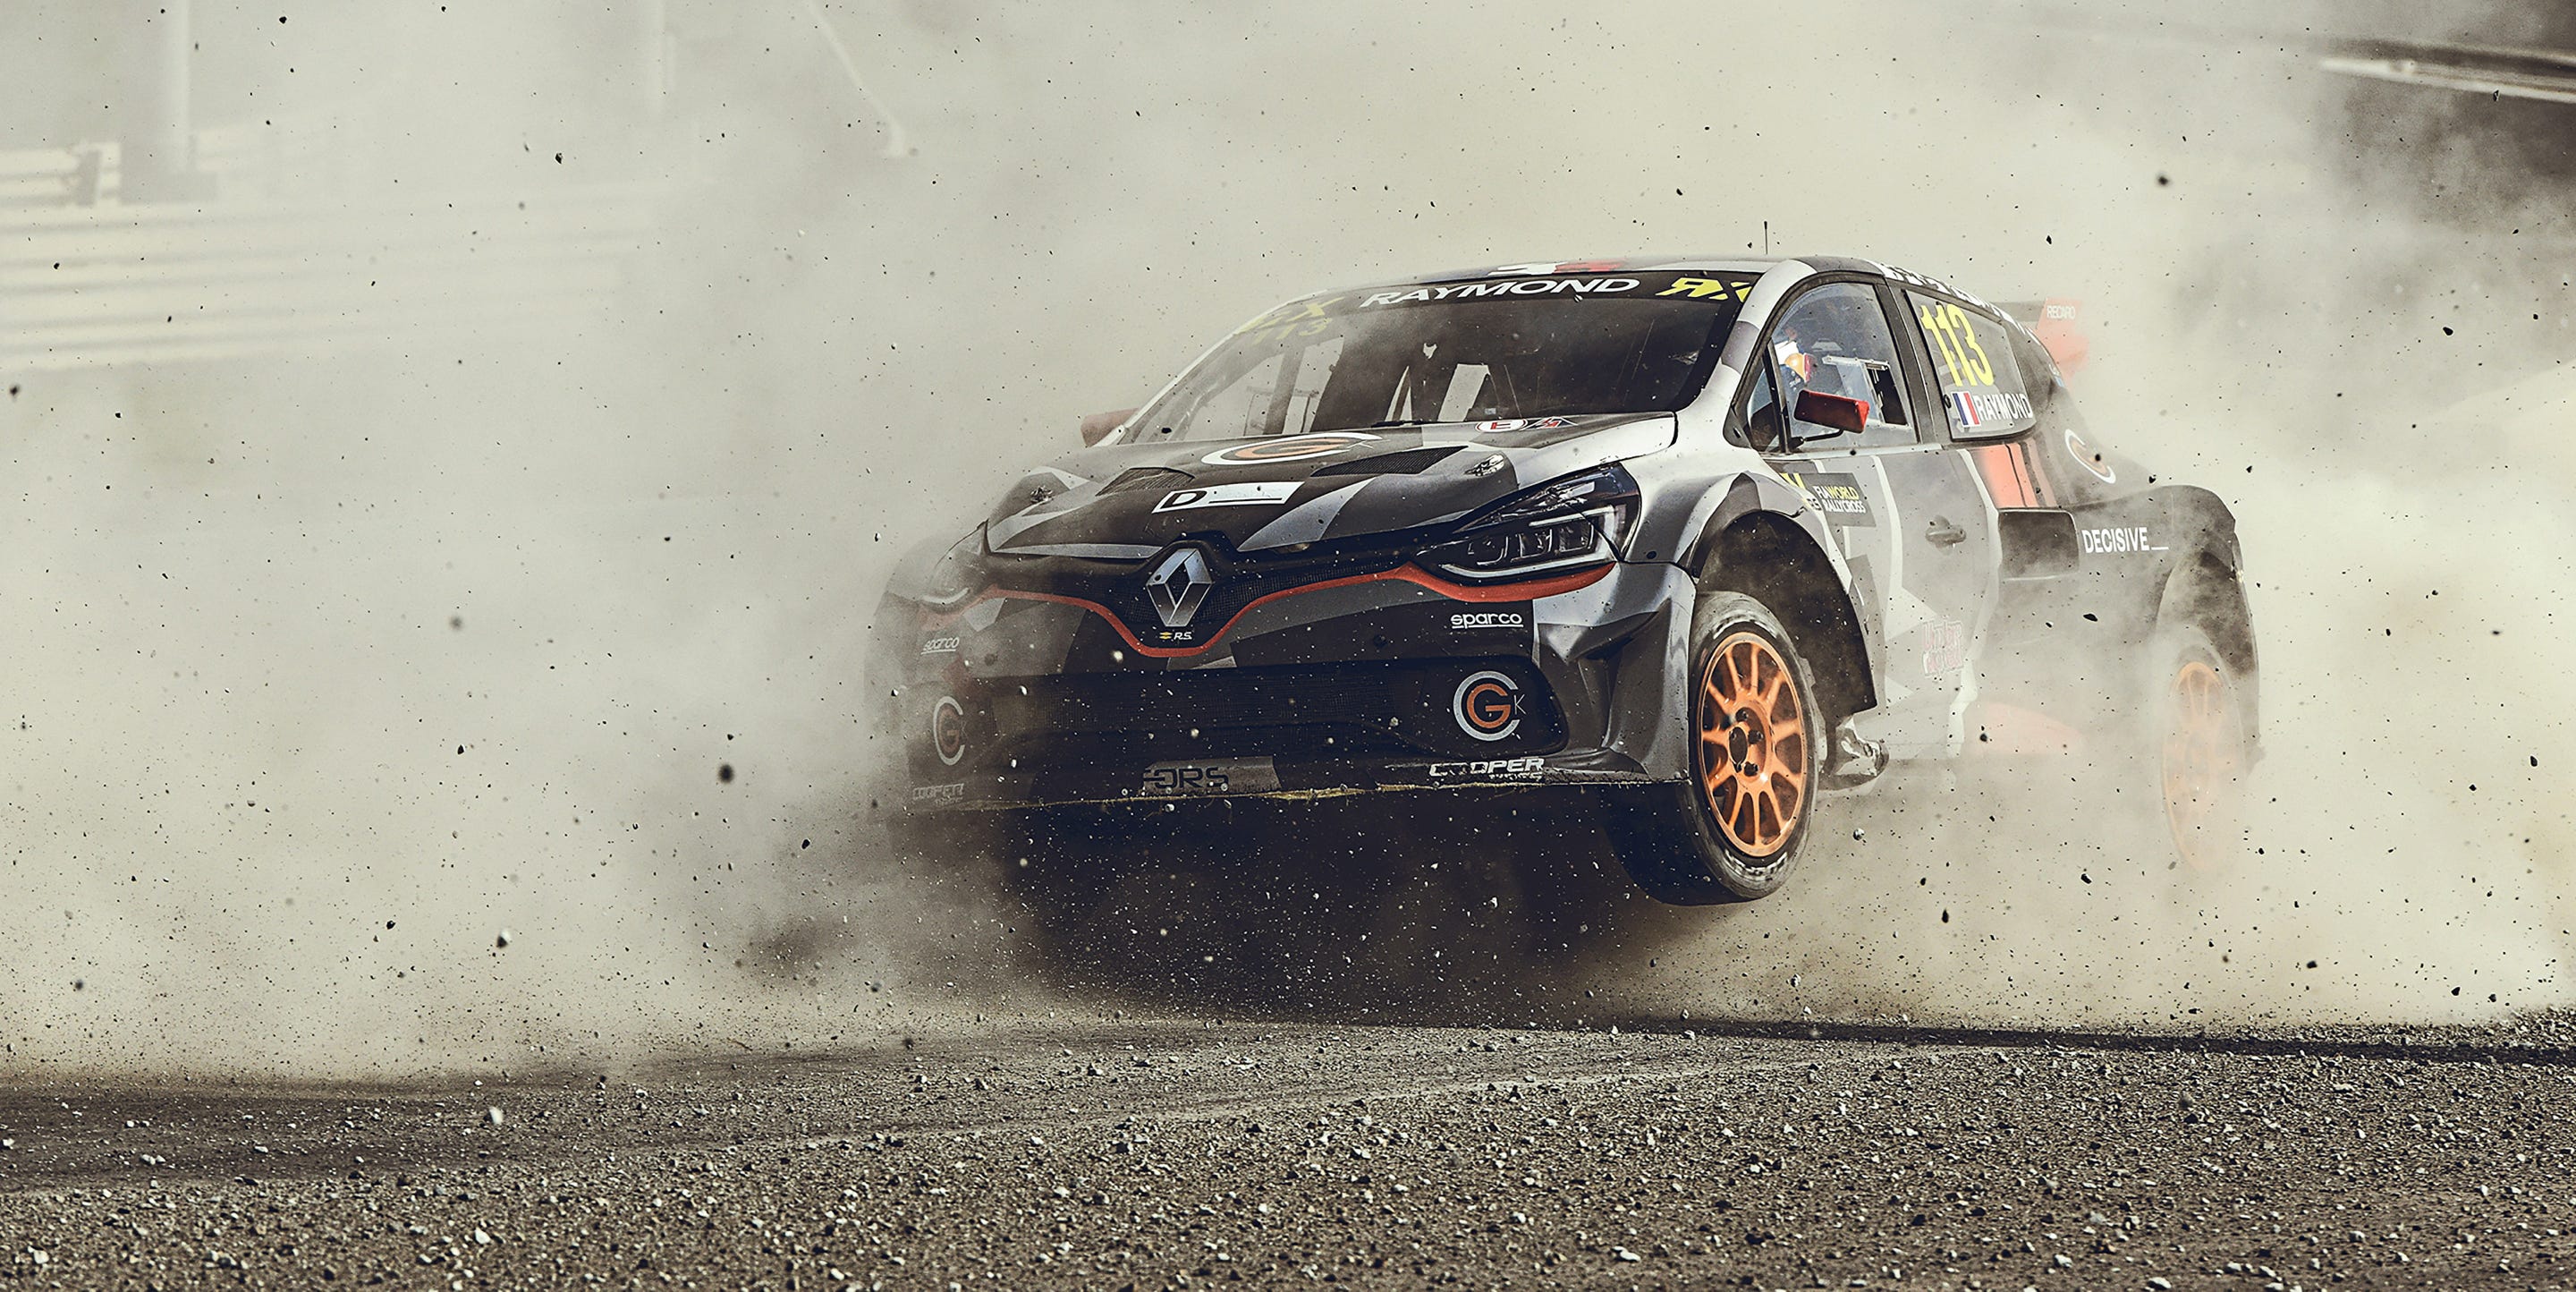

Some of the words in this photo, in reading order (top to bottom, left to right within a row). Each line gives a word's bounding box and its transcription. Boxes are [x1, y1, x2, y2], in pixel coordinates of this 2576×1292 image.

[1359, 278, 1640, 308] RAYMOND
[2046, 305, 2076, 319] RECARO
[1920, 303, 1995, 387] 113
[1972, 392, 2034, 421] RAYMOND
[1822, 498, 1867, 514] RALLYCROSS
[1450, 613, 1523, 629] sparco
[1429, 758, 1545, 777] COPER
